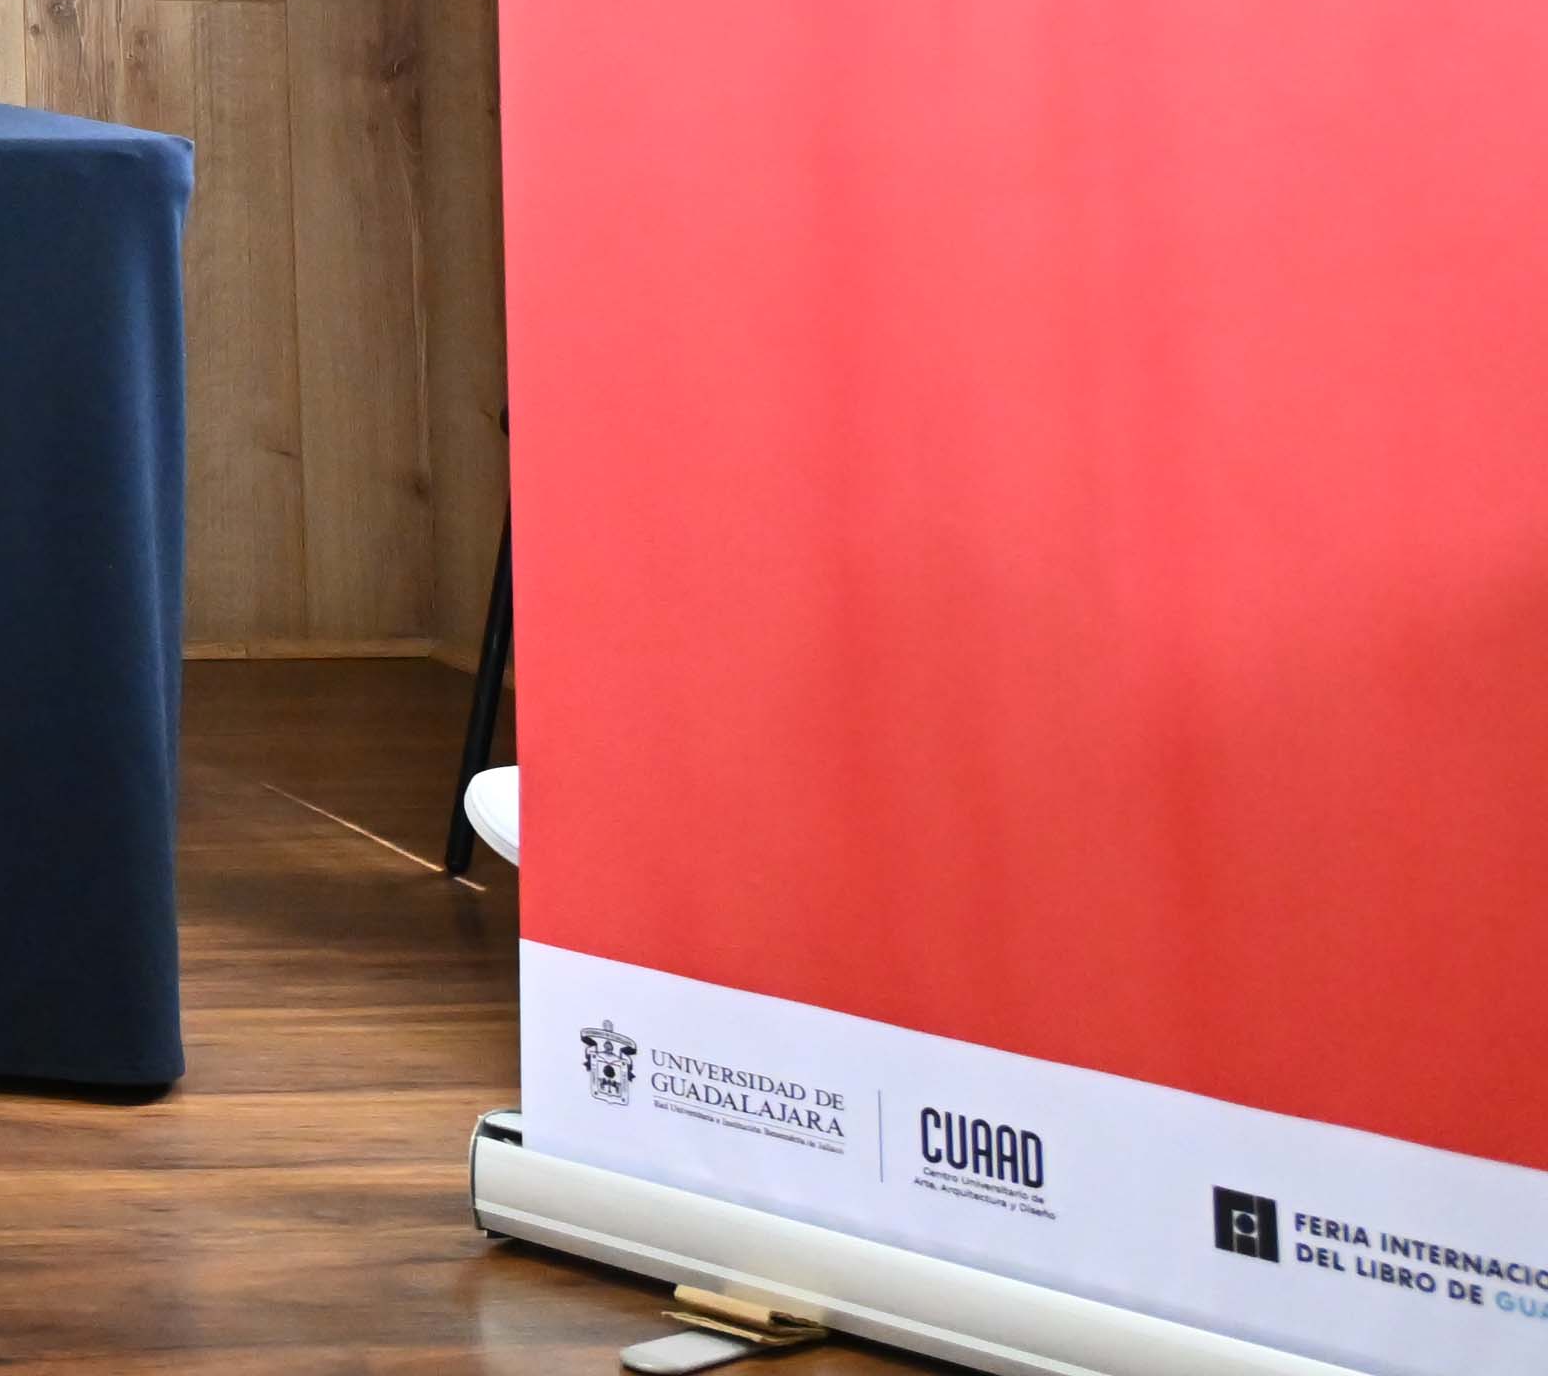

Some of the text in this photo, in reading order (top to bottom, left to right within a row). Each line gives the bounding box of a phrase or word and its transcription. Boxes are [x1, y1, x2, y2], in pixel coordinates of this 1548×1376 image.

[651, 1048, 845, 1111] UNIVERSIDAD DE
[651, 1073, 845, 1138] GUADALAJARA
[921, 1107, 1044, 1189] CUAAD
[1295, 1212, 1371, 1248] FERIA
[1295, 1242, 1346, 1273] DEL
[1356, 1255, 1438, 1294] LIBRO
[1448, 1278, 1485, 1306] DE
